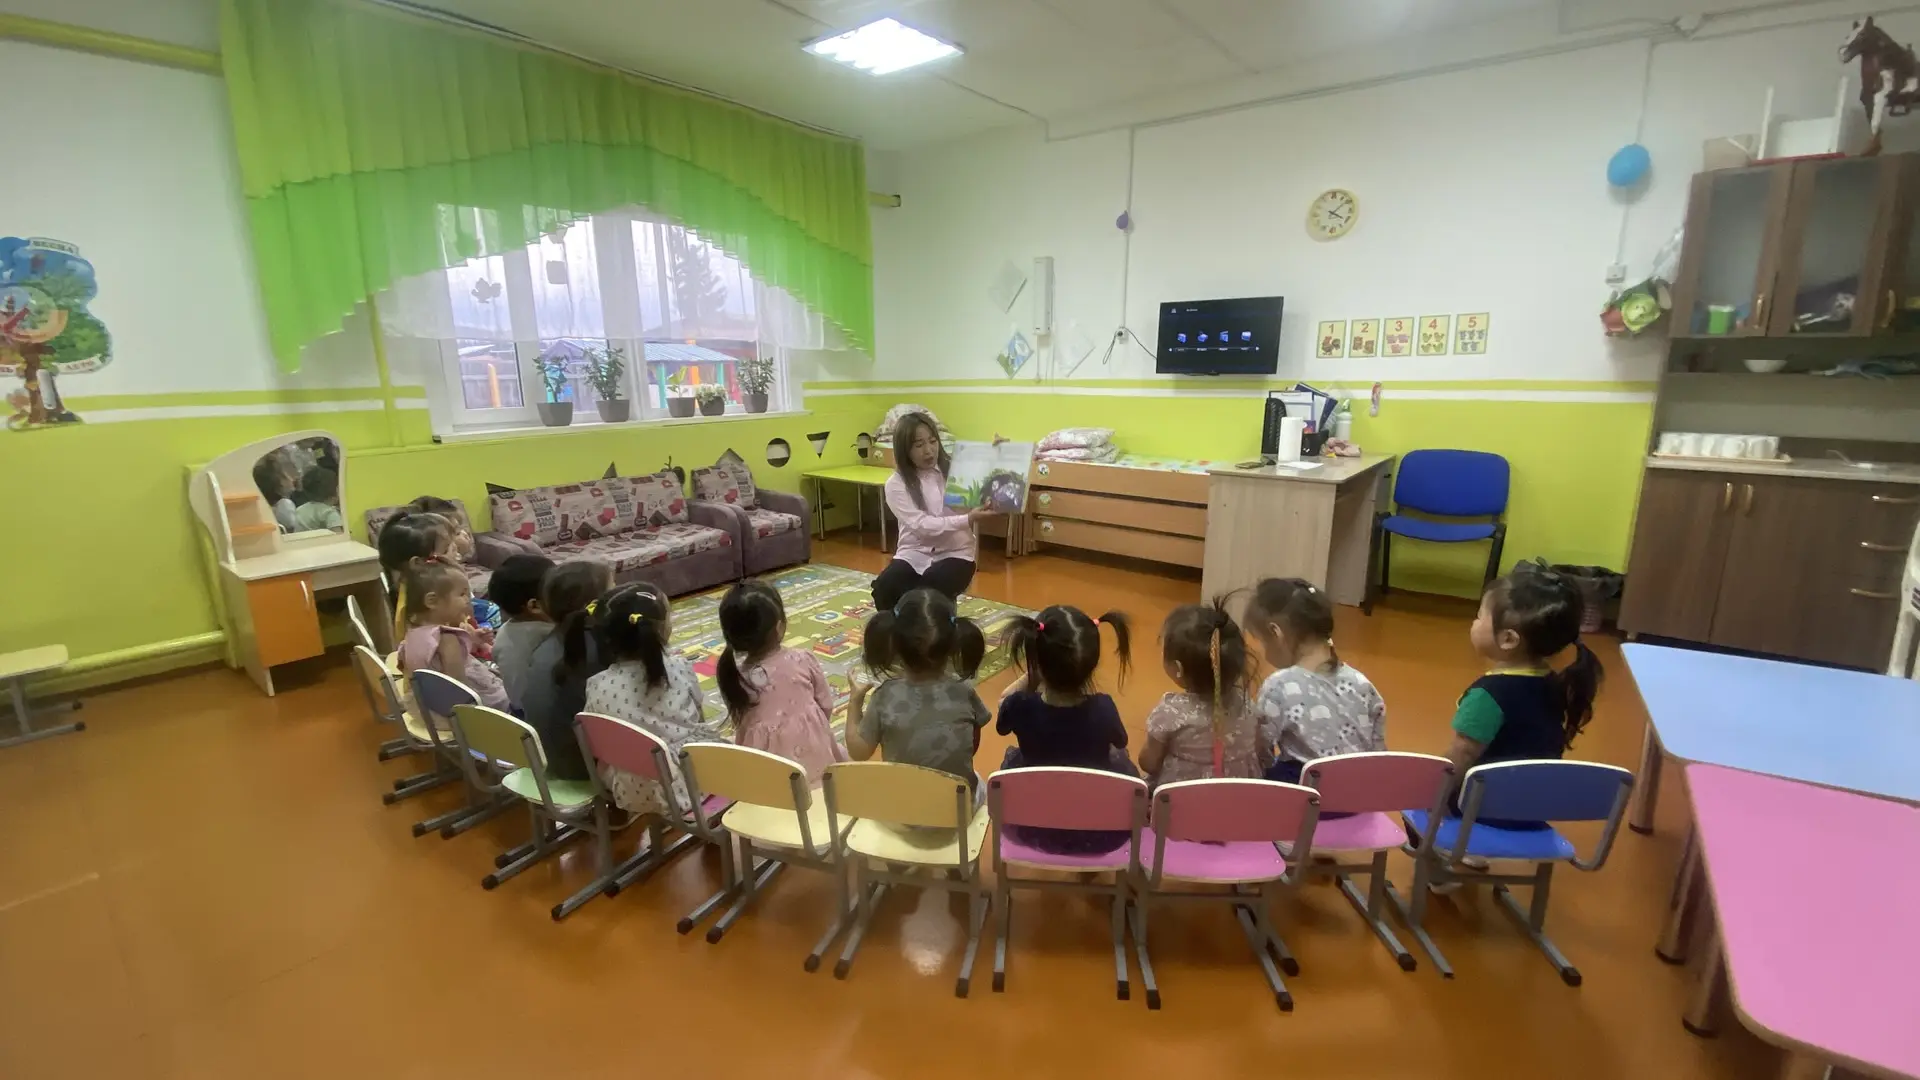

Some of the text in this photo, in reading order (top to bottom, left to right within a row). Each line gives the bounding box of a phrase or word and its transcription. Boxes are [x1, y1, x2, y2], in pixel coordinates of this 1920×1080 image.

[1360, 322, 1369, 333] 2
[1394, 320, 1403, 332] 3
[1428, 318, 1438, 330] 4
[1467, 316, 1477, 328] 5
[1328, 323, 1335, 334] 1
